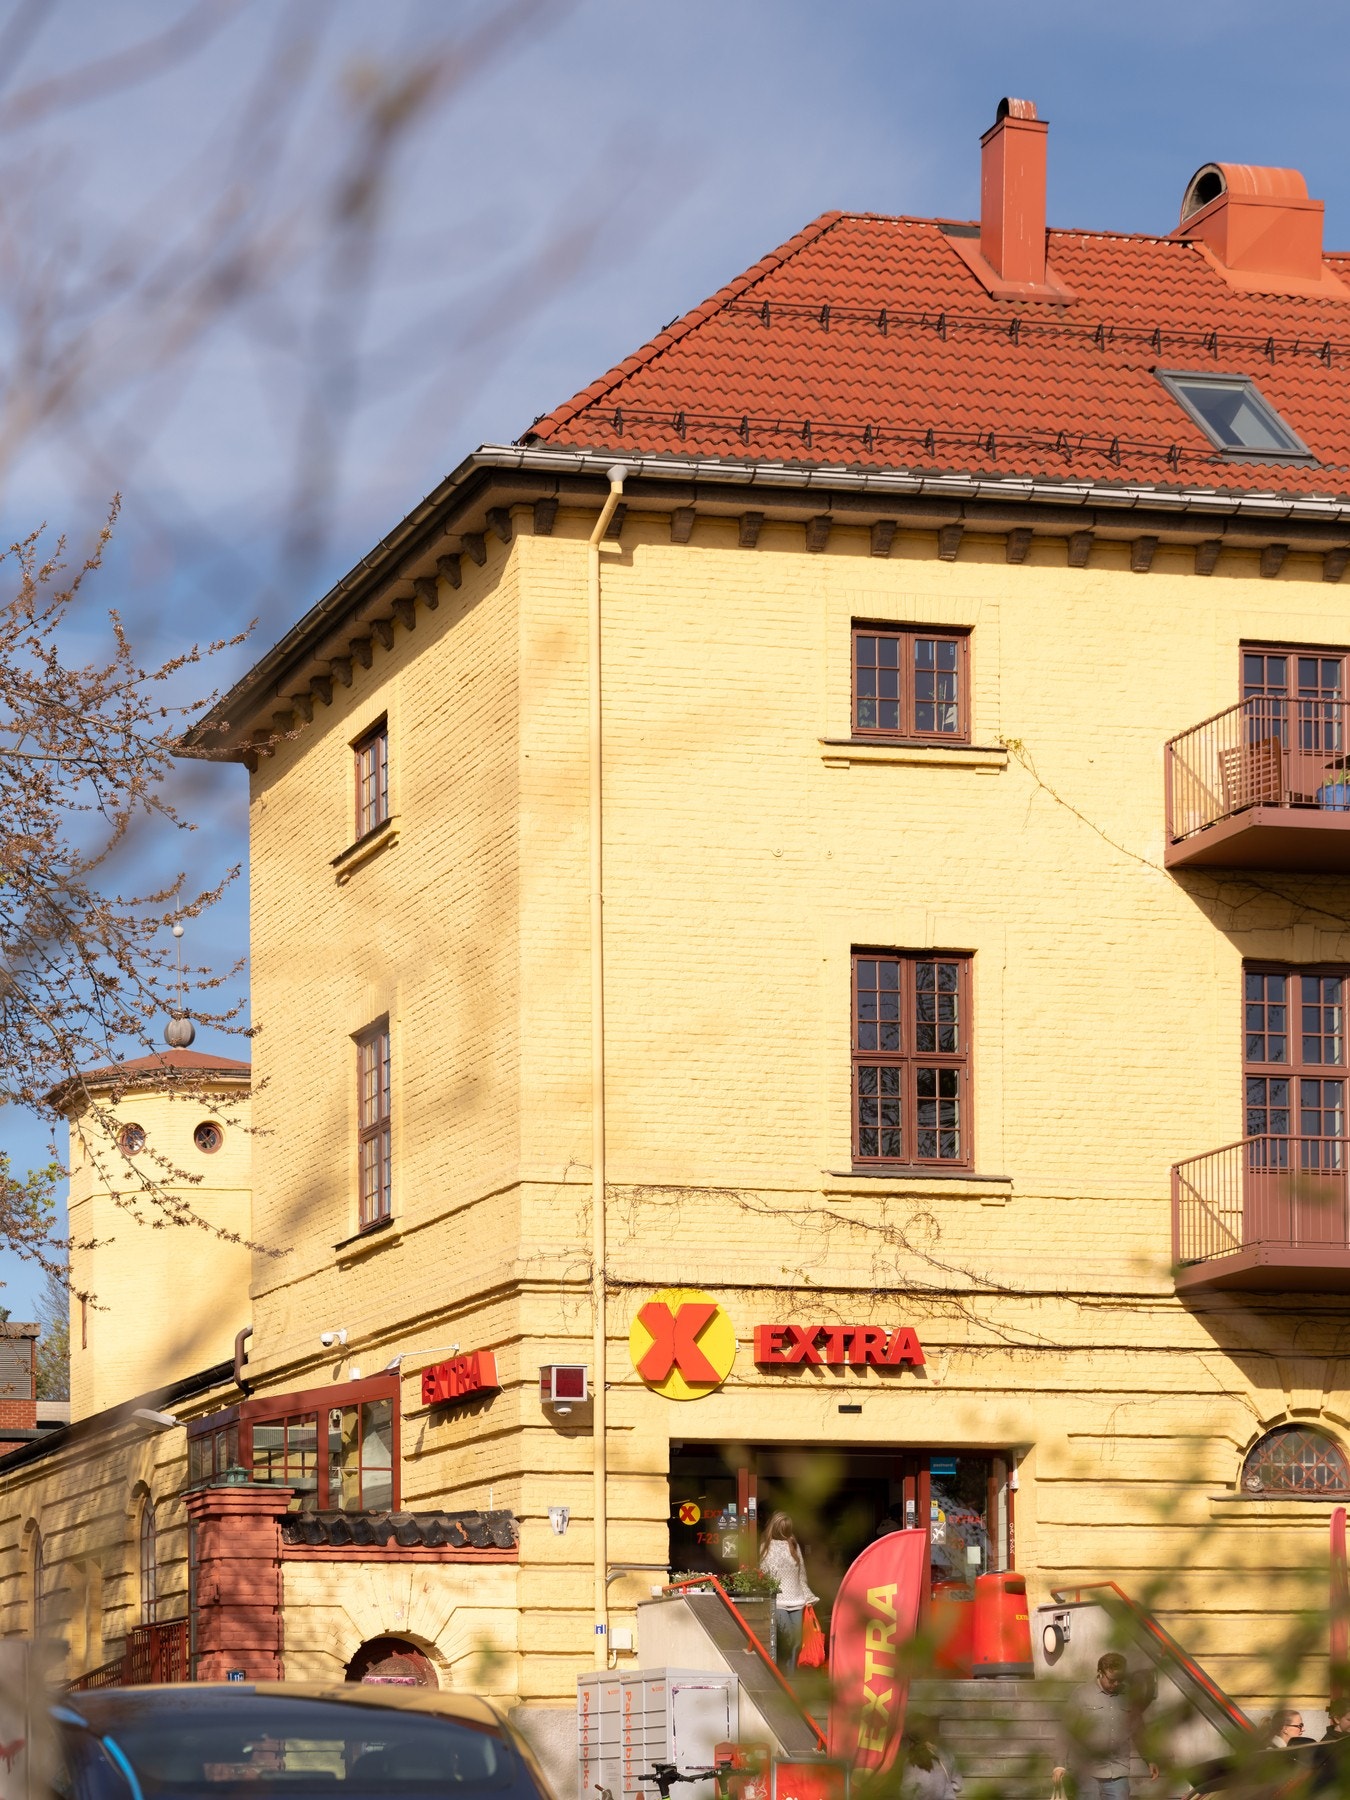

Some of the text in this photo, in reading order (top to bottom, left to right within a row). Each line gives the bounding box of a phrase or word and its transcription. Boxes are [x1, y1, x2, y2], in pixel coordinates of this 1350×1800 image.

[754, 1325, 927, 1366] EXTRA
[421, 1351, 489, 1405] EXTRA
[697, 1532, 720, 1545] 7-23
[857, 1583, 898, 1753] EXTRA
